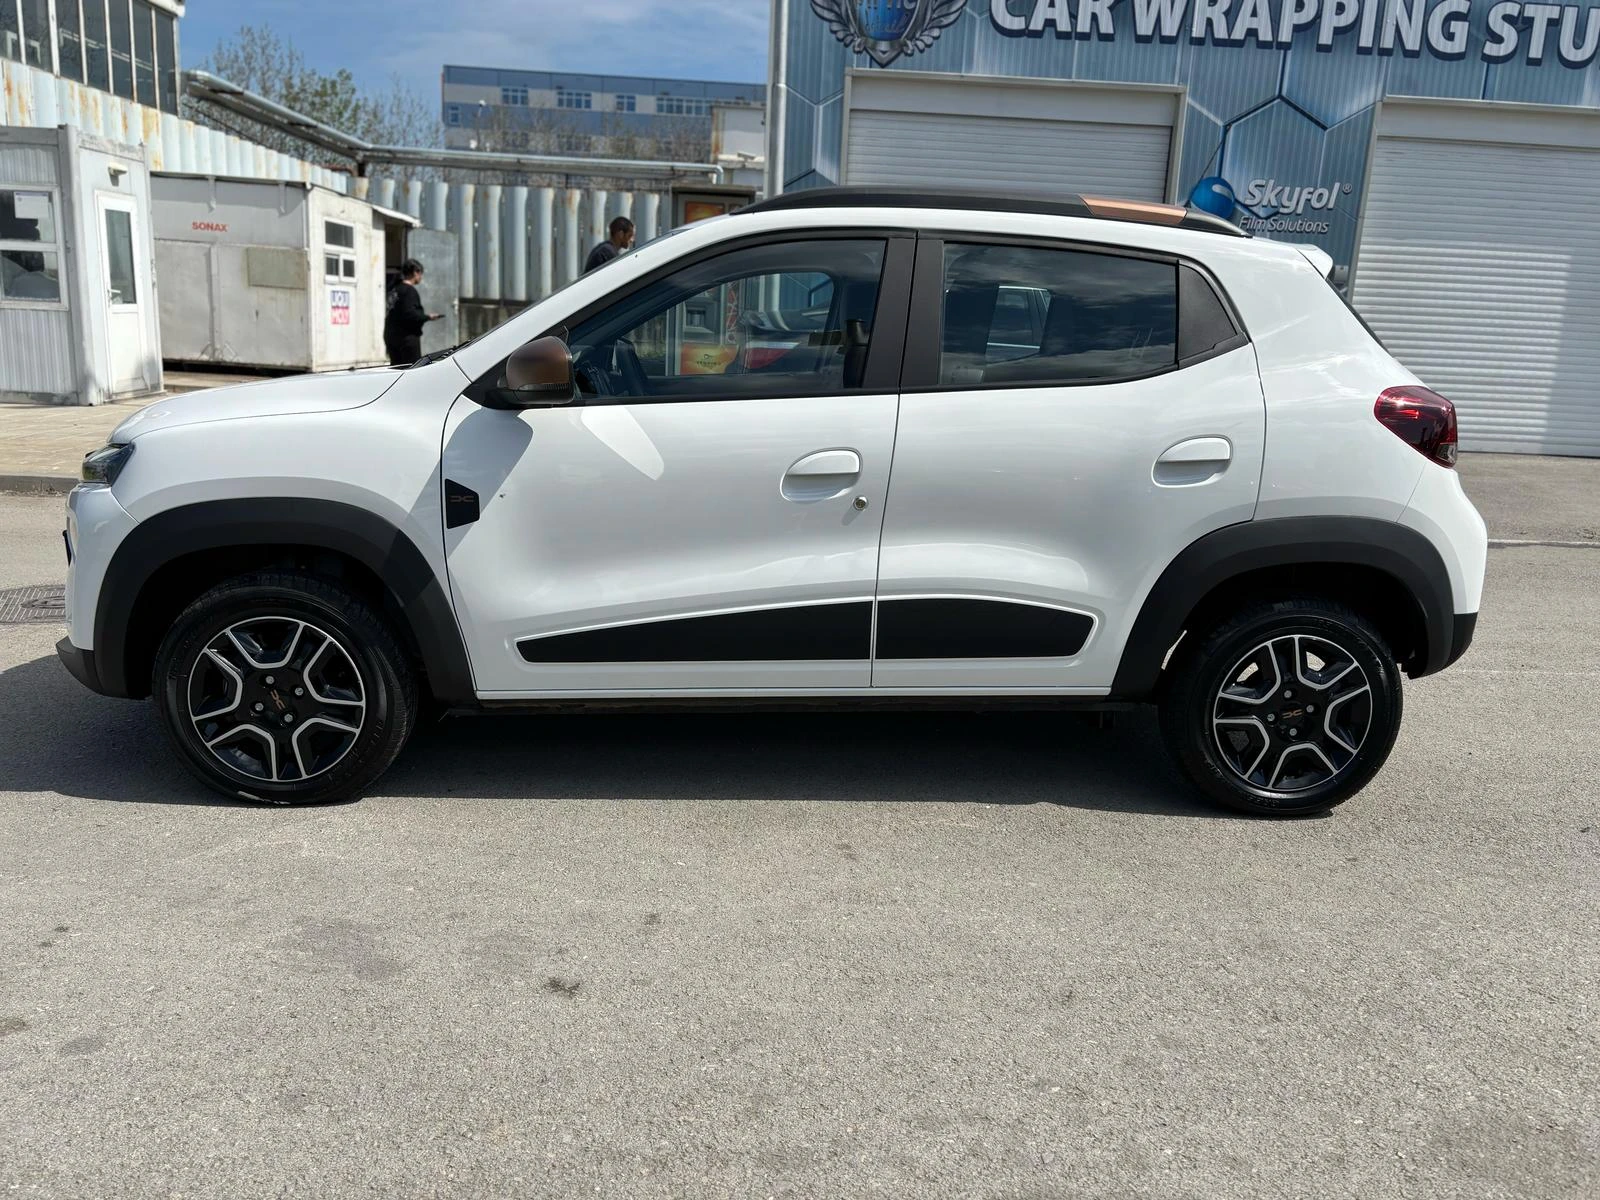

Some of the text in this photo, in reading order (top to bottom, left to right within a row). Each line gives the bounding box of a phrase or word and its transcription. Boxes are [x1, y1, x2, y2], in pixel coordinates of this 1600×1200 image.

[989, 0, 1600, 66] CAR WRAPPING STU
[192, 221, 228, 232] SONAX
[1239, 215, 1329, 234] Film Solutions
